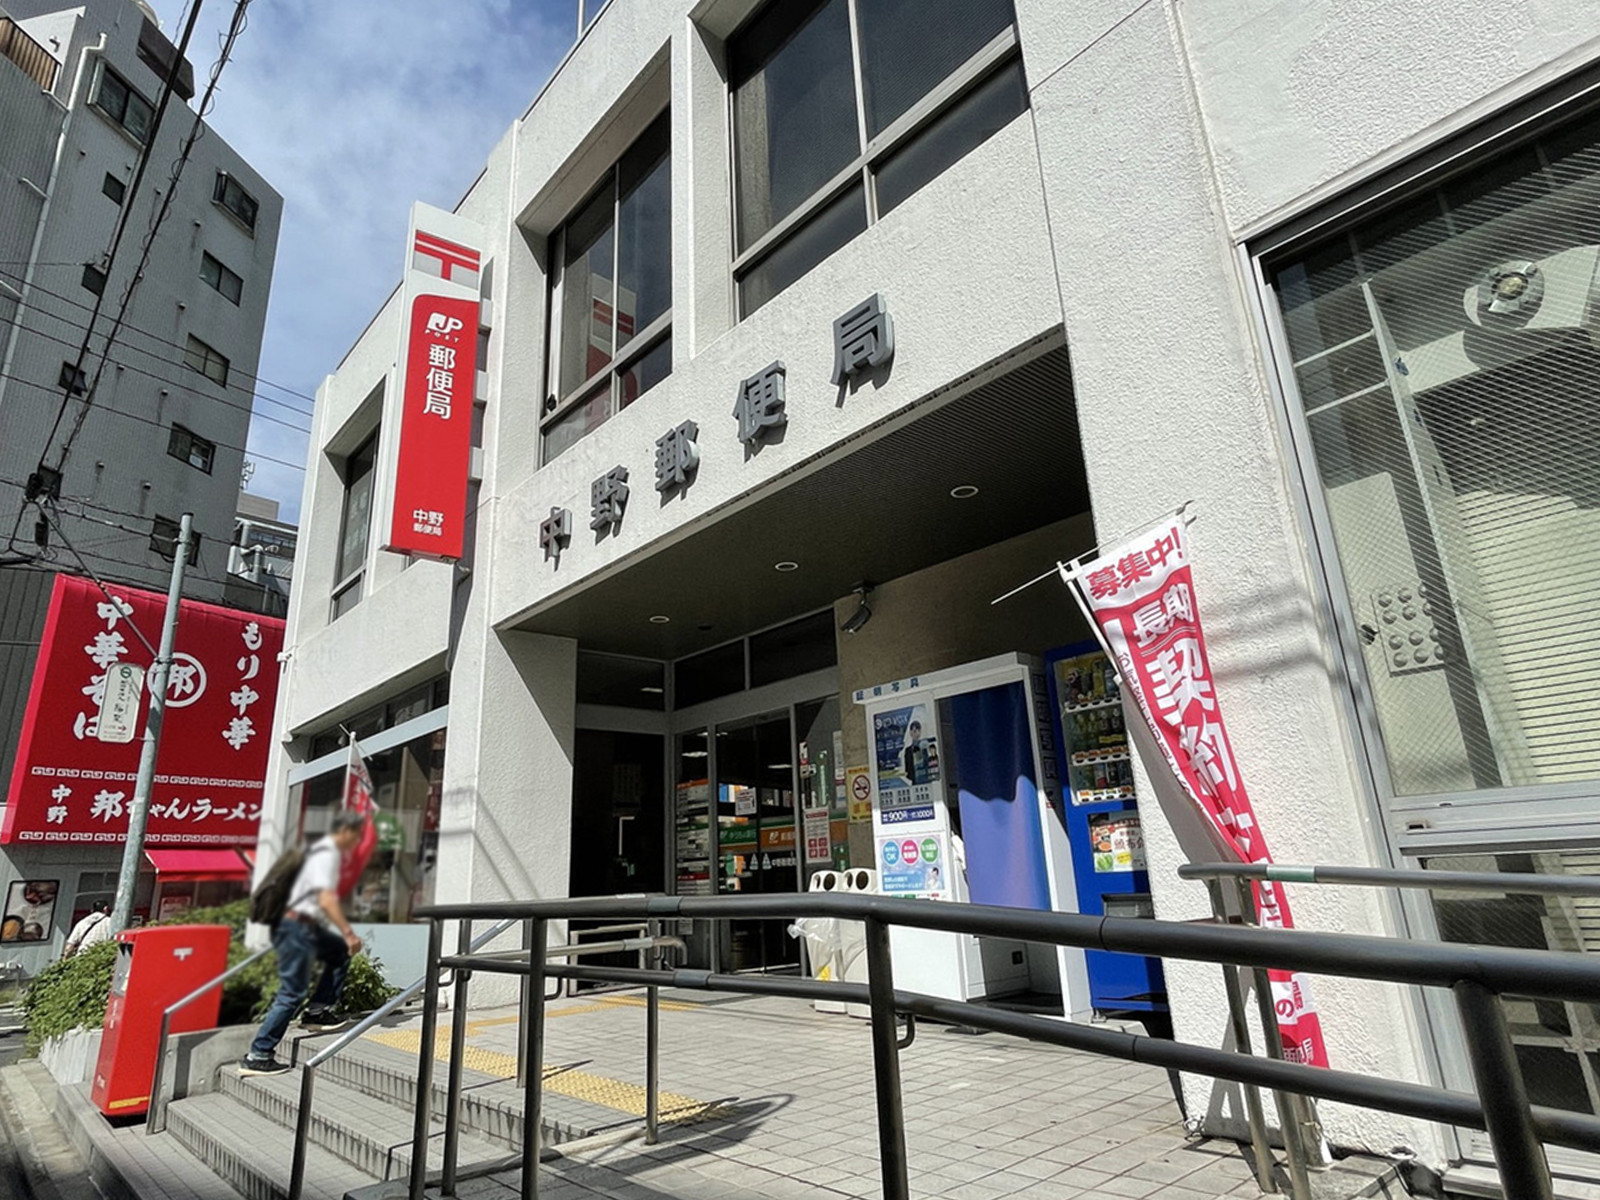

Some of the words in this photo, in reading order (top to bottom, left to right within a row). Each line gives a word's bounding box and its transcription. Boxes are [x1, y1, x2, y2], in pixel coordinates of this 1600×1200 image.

[423, 343, 455, 420] 郵便局
[540, 292, 894, 560] 中野郵便局
[413, 508, 444, 527] 中野
[413, 522, 442, 537] 郵便局
[1085, 526, 1184, 600] 募集中!
[1132, 582, 1195, 648] 長期
[222, 621, 263, 750] もり中華
[46, 783, 73, 824] 中野
[90, 789, 262, 823] 邦ゃんラーメン
